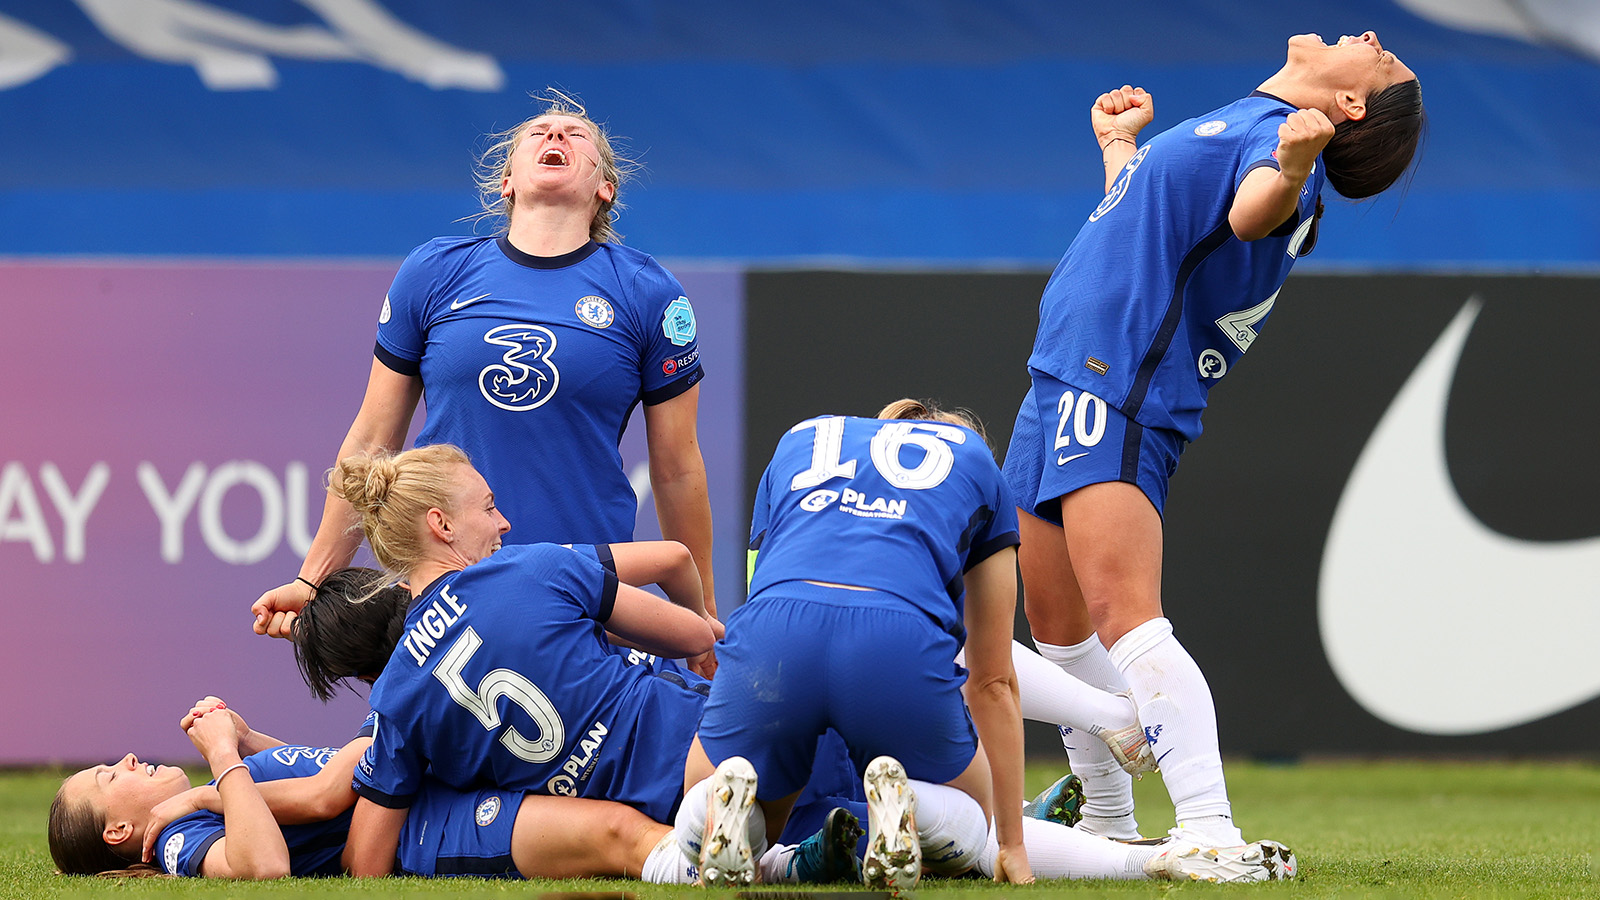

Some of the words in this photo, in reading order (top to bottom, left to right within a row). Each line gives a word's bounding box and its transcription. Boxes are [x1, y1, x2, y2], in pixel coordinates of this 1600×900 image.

[478, 324, 560, 412] 3
[790, 416, 967, 491] 16
[1054, 390, 1108, 451] 20
[0, 460, 110, 565] AY
[838, 505, 903, 520] INTERNATIONAL
[841, 488, 907, 517] PLAN
[403, 584, 468, 668] INGLE
[431, 625, 565, 764] 5
[563, 721, 608, 778] PLAN
